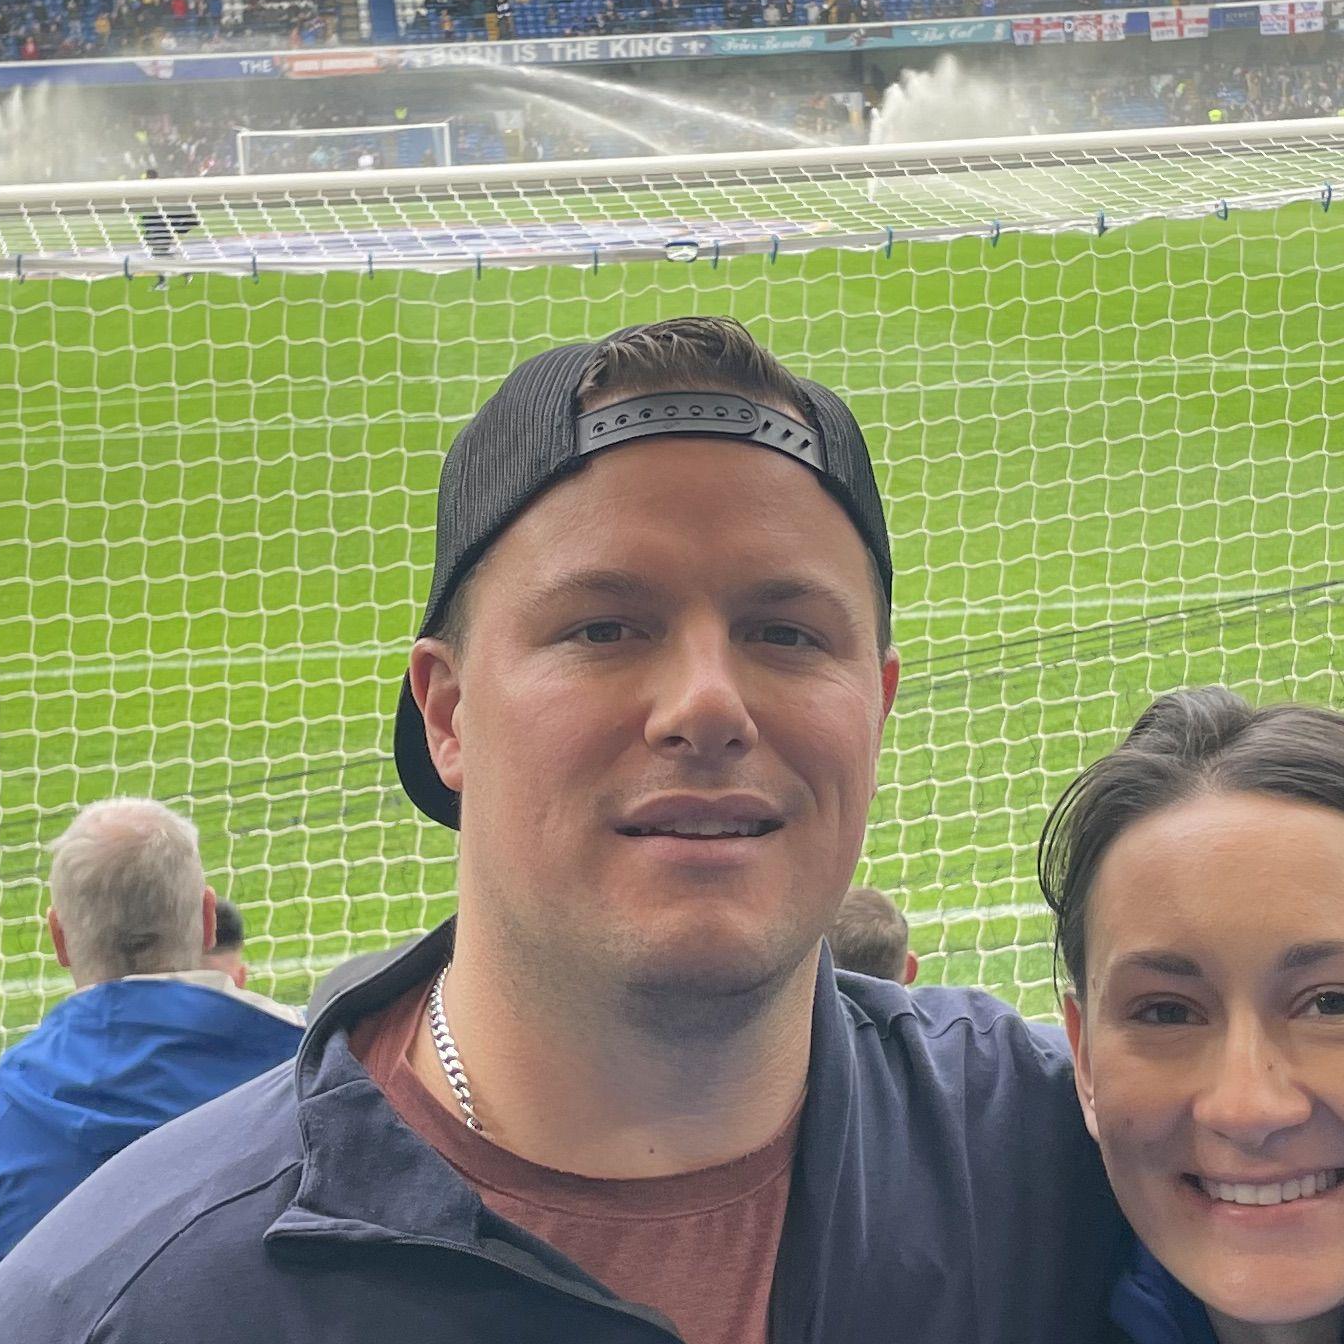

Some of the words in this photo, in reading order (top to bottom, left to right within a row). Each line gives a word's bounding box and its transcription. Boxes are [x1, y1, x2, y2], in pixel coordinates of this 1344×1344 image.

[512, 43, 537, 62] IS
[548, 41, 600, 60] THE
[609, 36, 673, 58] KING
[239, 59, 273, 74] THE
